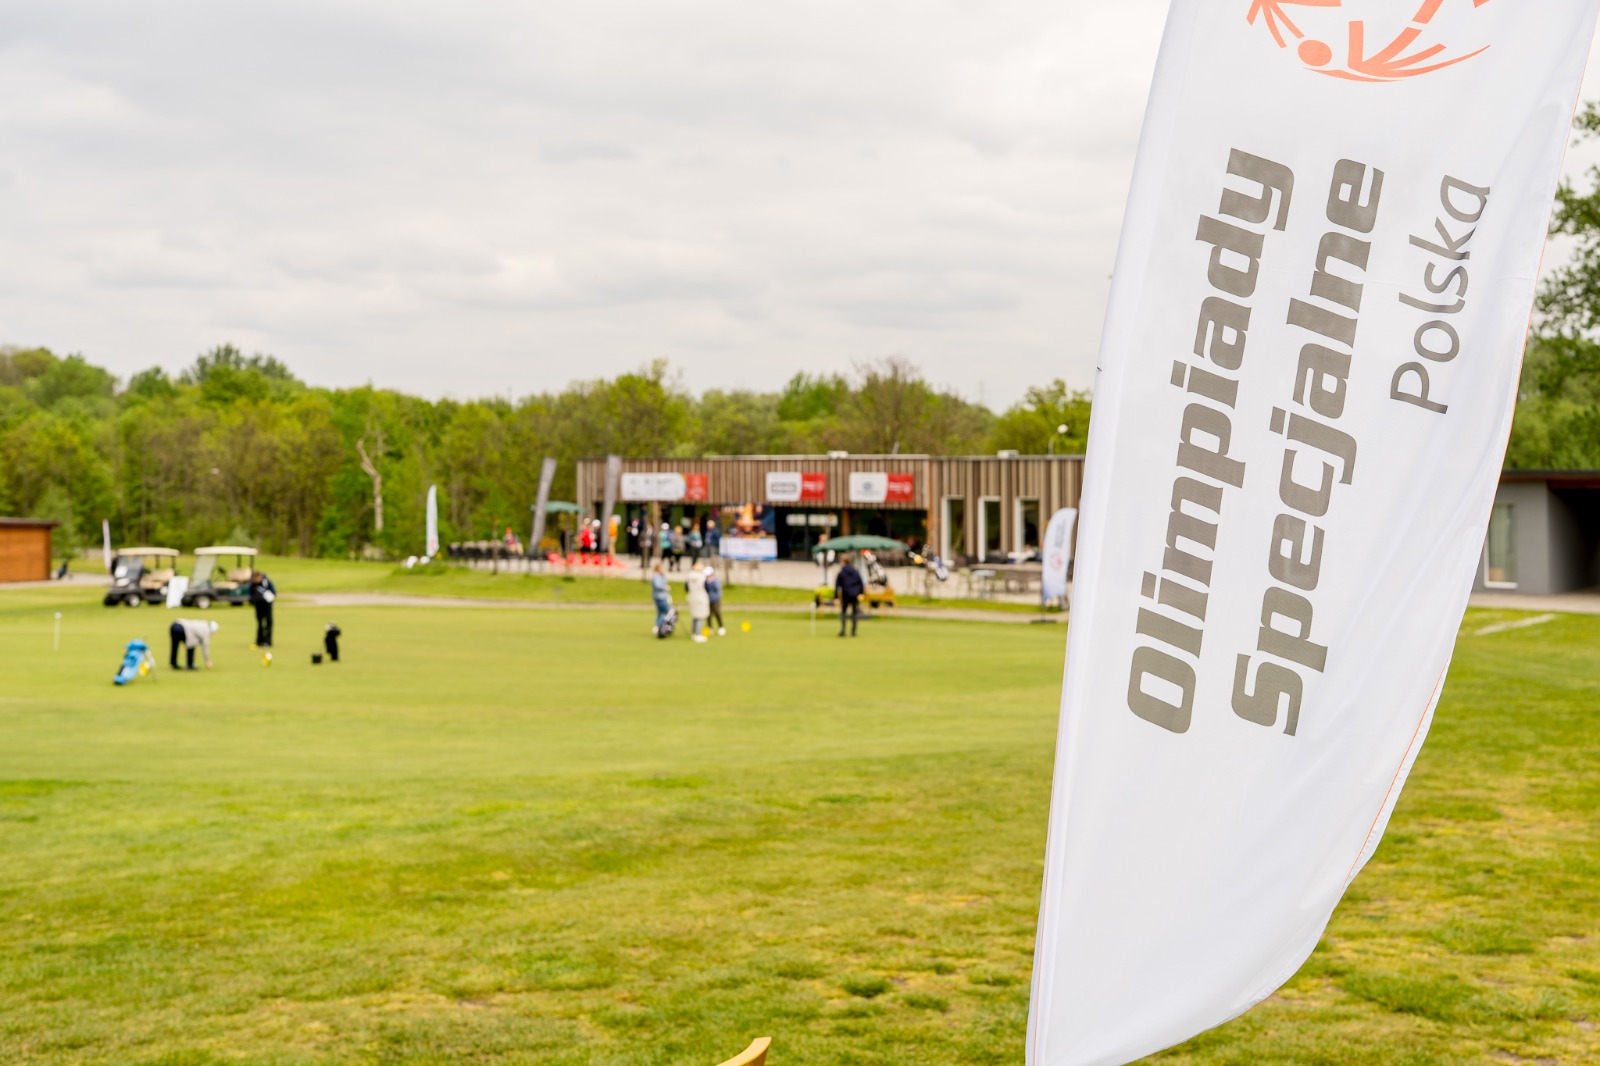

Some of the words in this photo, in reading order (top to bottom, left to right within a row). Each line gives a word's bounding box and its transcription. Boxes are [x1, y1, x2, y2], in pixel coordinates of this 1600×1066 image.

[1126, 147, 1295, 734] Olimpiady
[1230, 158, 1385, 737] Specjalne
[1389, 174, 1491, 415] Polska
